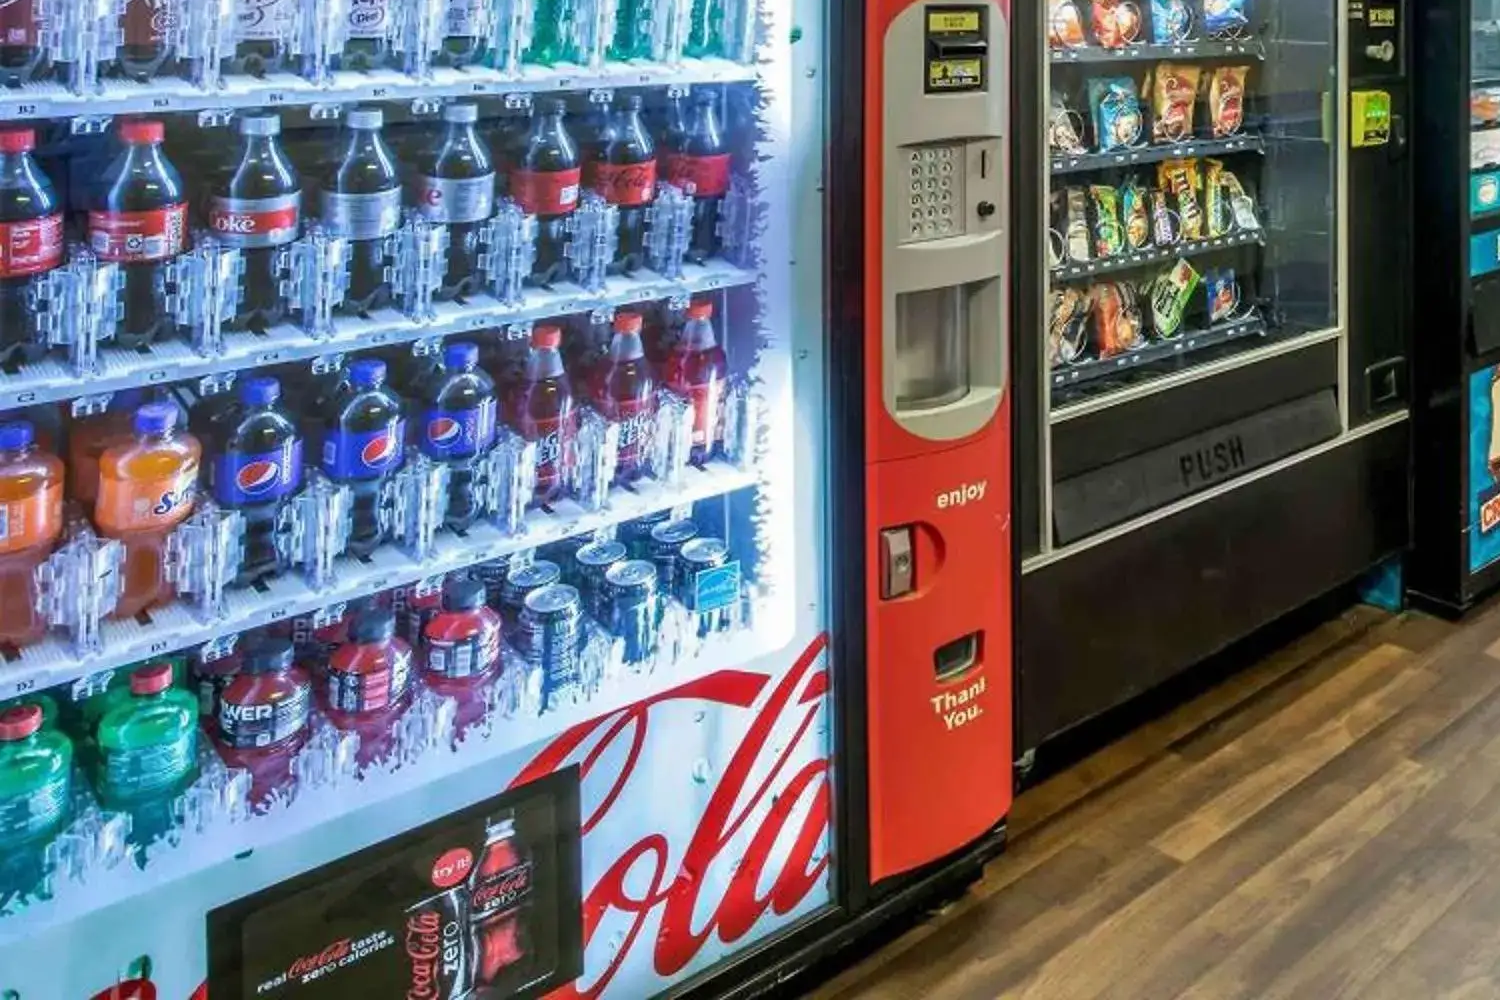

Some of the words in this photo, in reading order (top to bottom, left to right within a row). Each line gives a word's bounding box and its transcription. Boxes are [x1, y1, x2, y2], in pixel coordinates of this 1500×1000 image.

[1178, 436, 1246, 488] PUSH
[937, 479, 987, 509] enjoy
[943, 704, 983, 731] You.
[433, 861, 455, 883] try
[483, 888, 518, 912] zero
[256, 973, 287, 994] real
[351, 929, 387, 953] taste
[301, 960, 338, 984] zero
[337, 934, 396, 970] calories
[442, 919, 460, 977] zero
